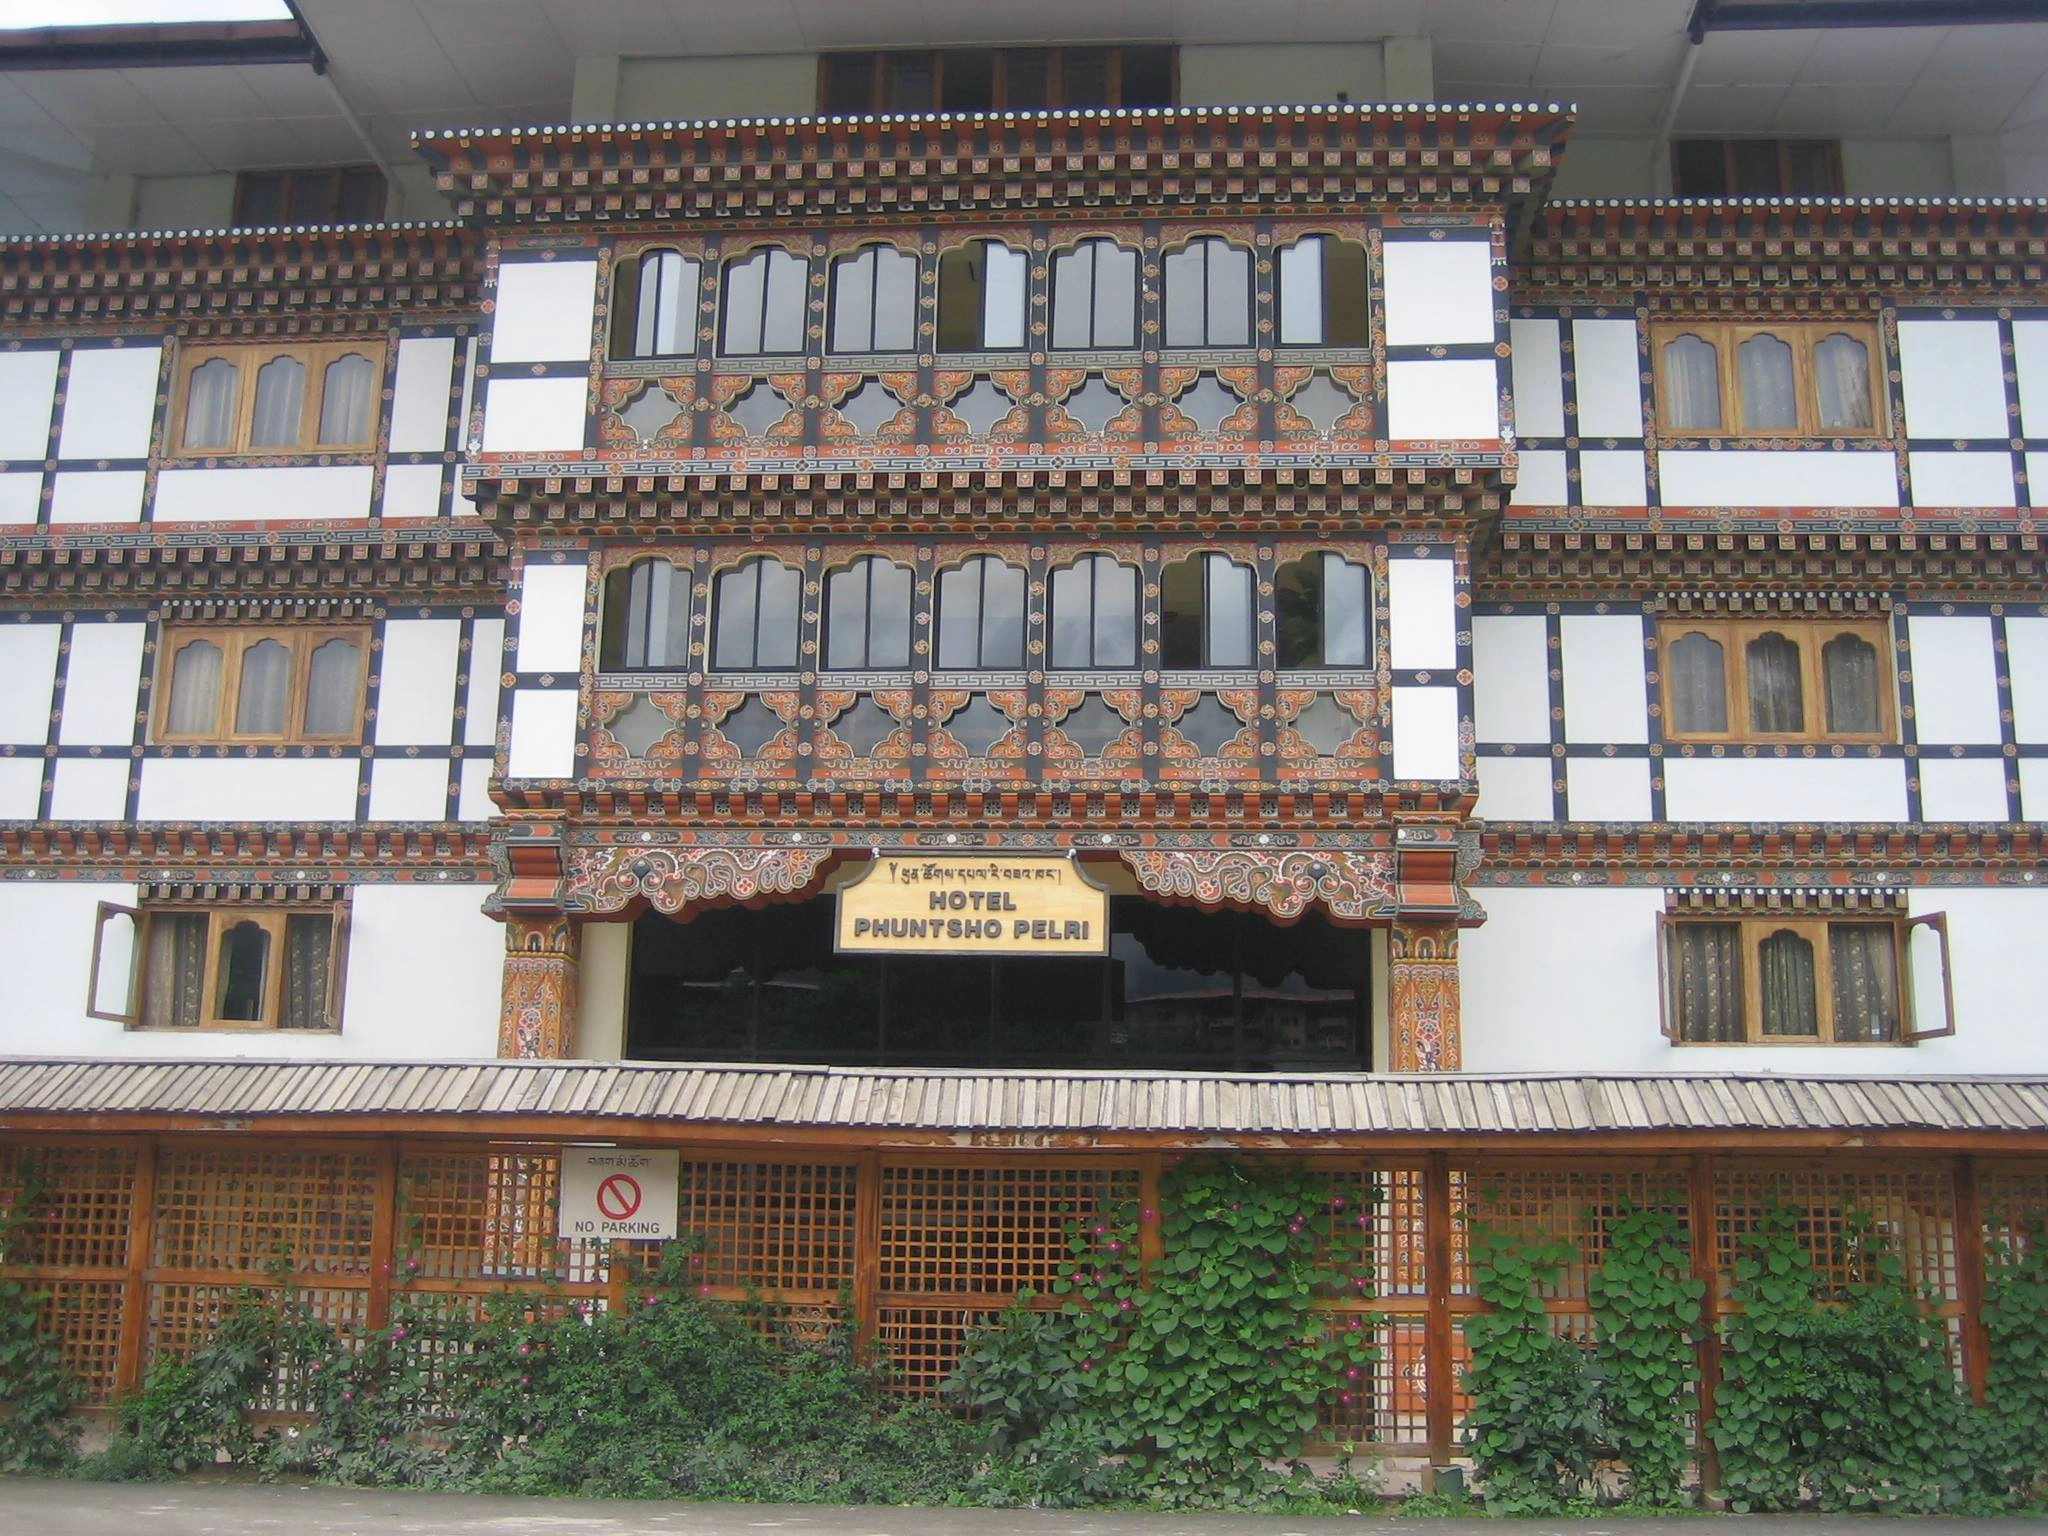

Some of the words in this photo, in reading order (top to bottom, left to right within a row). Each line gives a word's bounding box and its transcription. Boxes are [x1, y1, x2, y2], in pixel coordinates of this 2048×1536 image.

[929, 891, 1016, 911] HOTEL
[854, 918, 1002, 939] PHUNTSHO
[1013, 920, 1090, 940] PELRI
[575, 1221, 594, 1232] NO
[601, 1221, 660, 1234] PARKING
